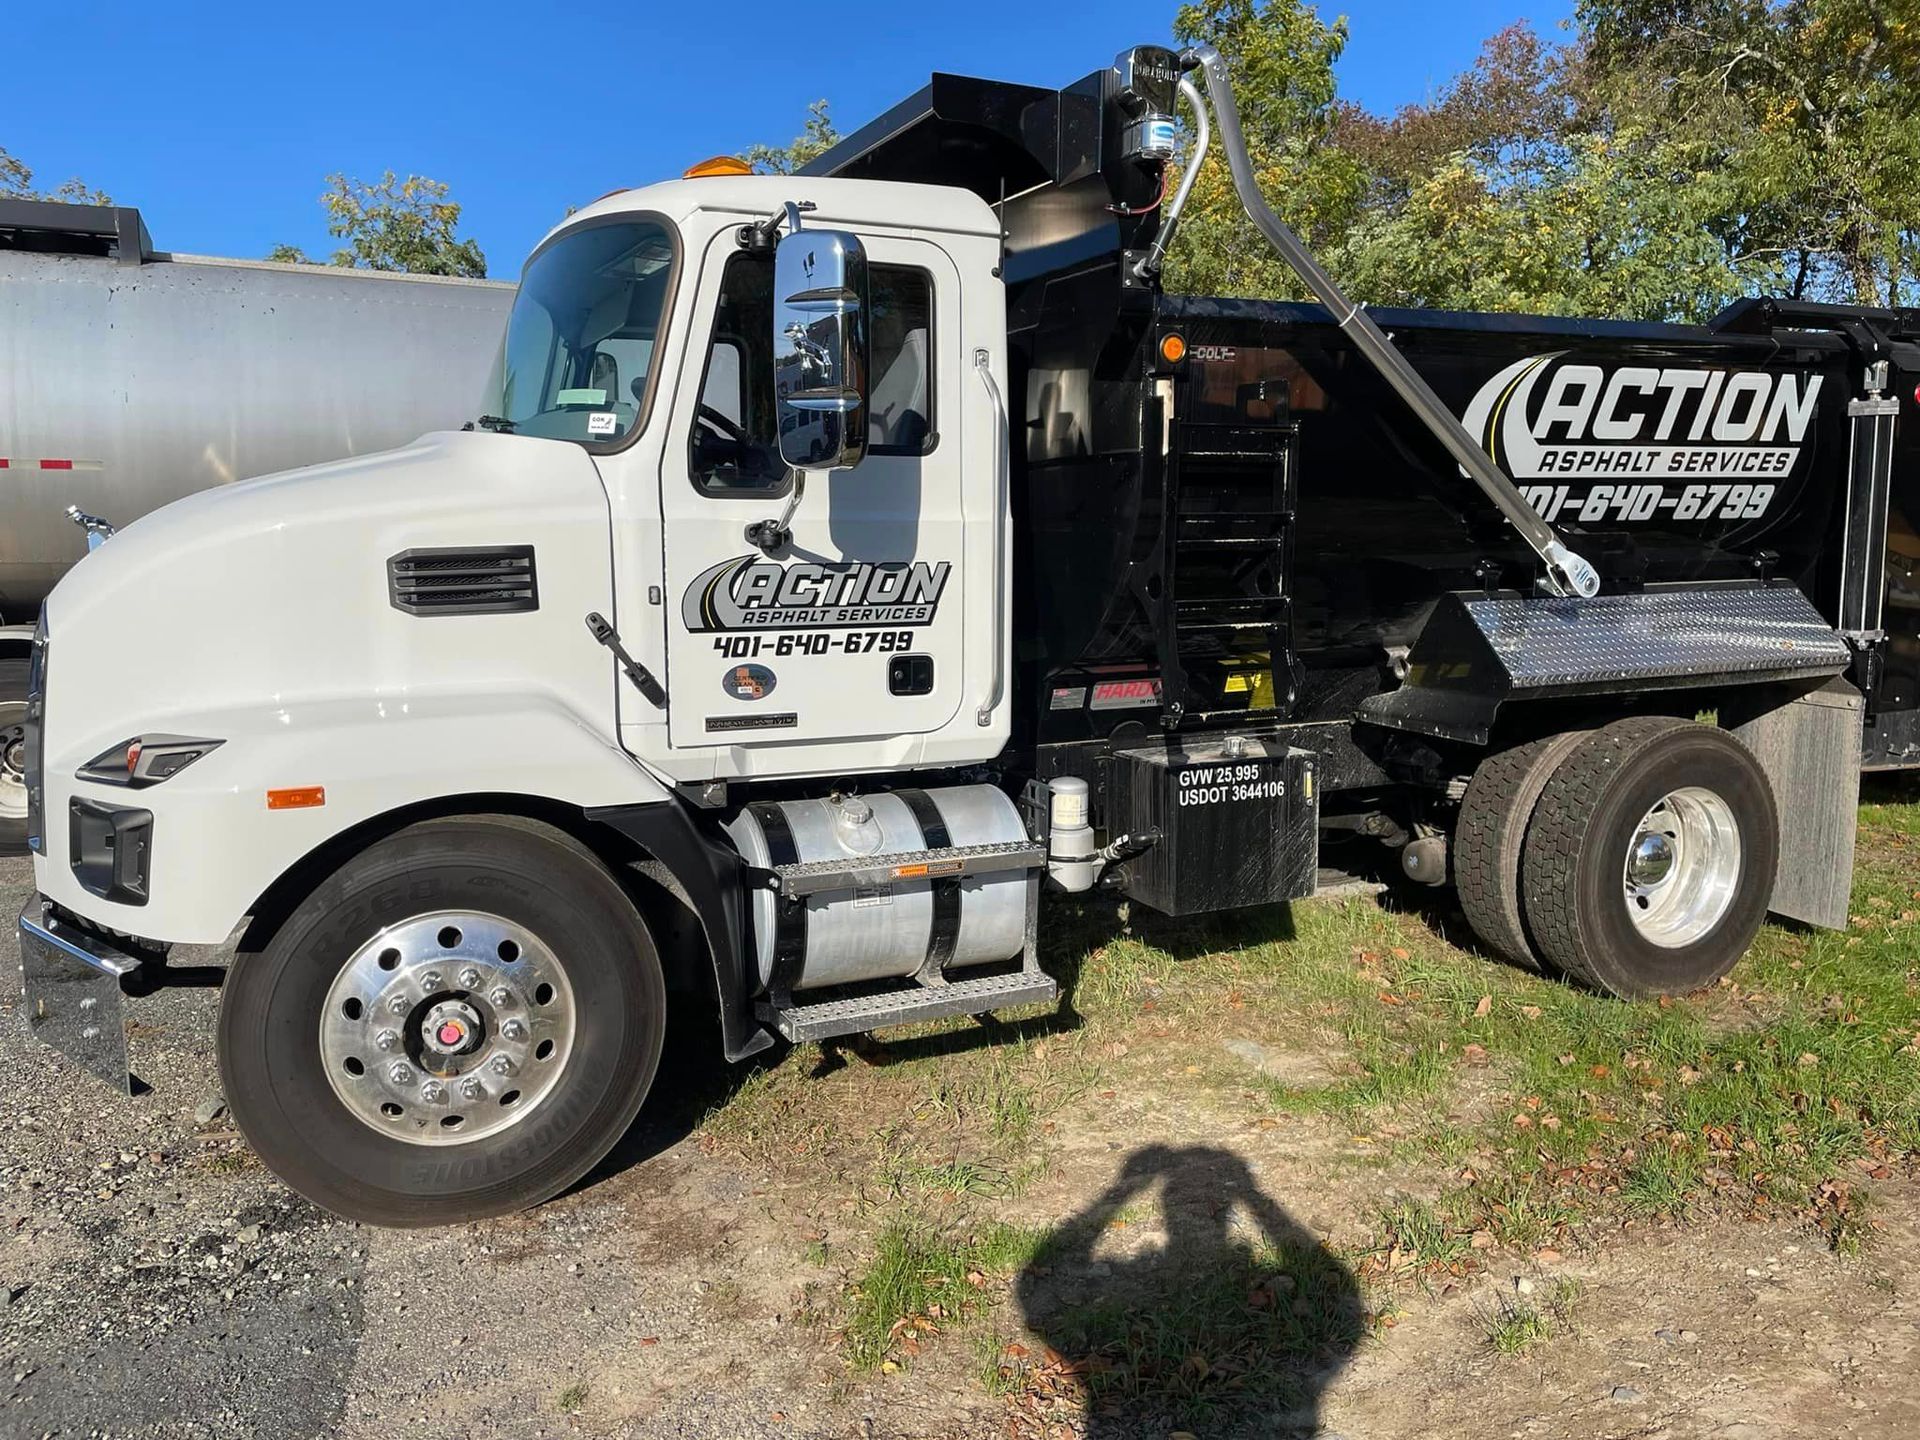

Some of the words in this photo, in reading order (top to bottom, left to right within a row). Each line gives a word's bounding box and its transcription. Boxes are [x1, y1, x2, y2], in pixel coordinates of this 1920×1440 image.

[1197, 347, 1228, 360] COLT
[1532, 365, 1824, 442] ACTION
[1538, 450, 1661, 473] ASPHALT
[1667, 451, 1790, 472] SERVICES
[1504, 484, 1776, 522] 01-640-6799
[735, 561, 952, 607] ACTION
[742, 609, 831, 625] ASPHALT
[836, 606, 928, 622] SERVICES
[713, 631, 914, 658] 401-640-6799
[1180, 768, 1213, 786] GVW
[1216, 764, 1259, 785] 25,995
[1180, 786, 1229, 806] USDOT
[1232, 780, 1285, 801] 3644106
